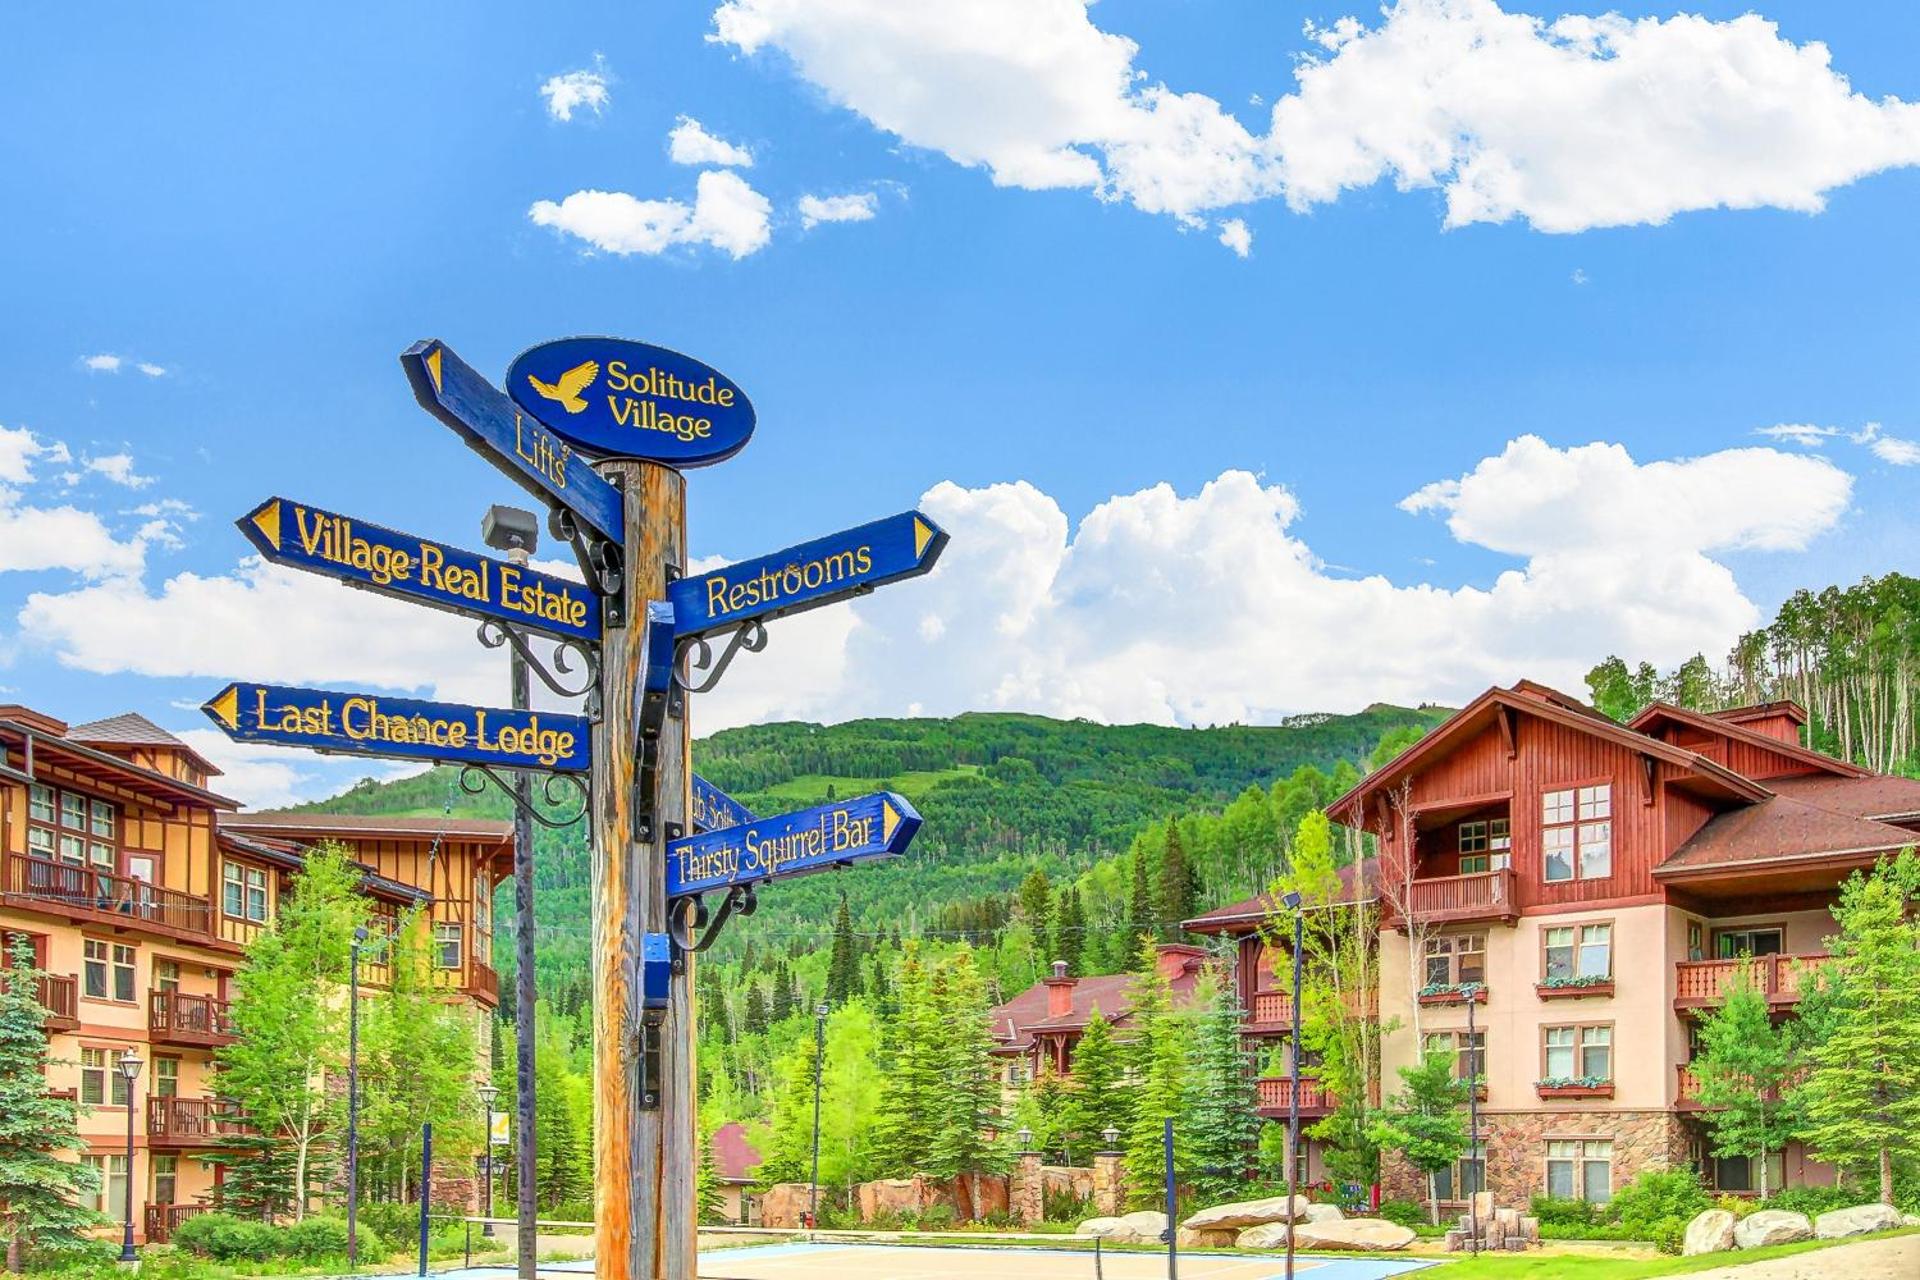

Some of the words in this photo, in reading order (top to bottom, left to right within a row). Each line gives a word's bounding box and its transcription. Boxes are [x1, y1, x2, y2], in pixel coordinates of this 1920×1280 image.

[607, 361, 735, 407] Solitude
[608, 396, 711, 441] Village
[515, 412, 566, 489] Lifts
[295, 507, 410, 584] Village
[420, 542, 490, 602] Real
[500, 566, 587, 628] Estate
[706, 545, 871, 618] Restrooms
[256, 689, 333, 735] Last
[342, 698, 466, 747] Chance
[475, 710, 574, 765] Lodge
[675, 843, 740, 884] Thirsty
[745, 813, 827, 874] Squirrel
[832, 809, 874, 851] Bar
